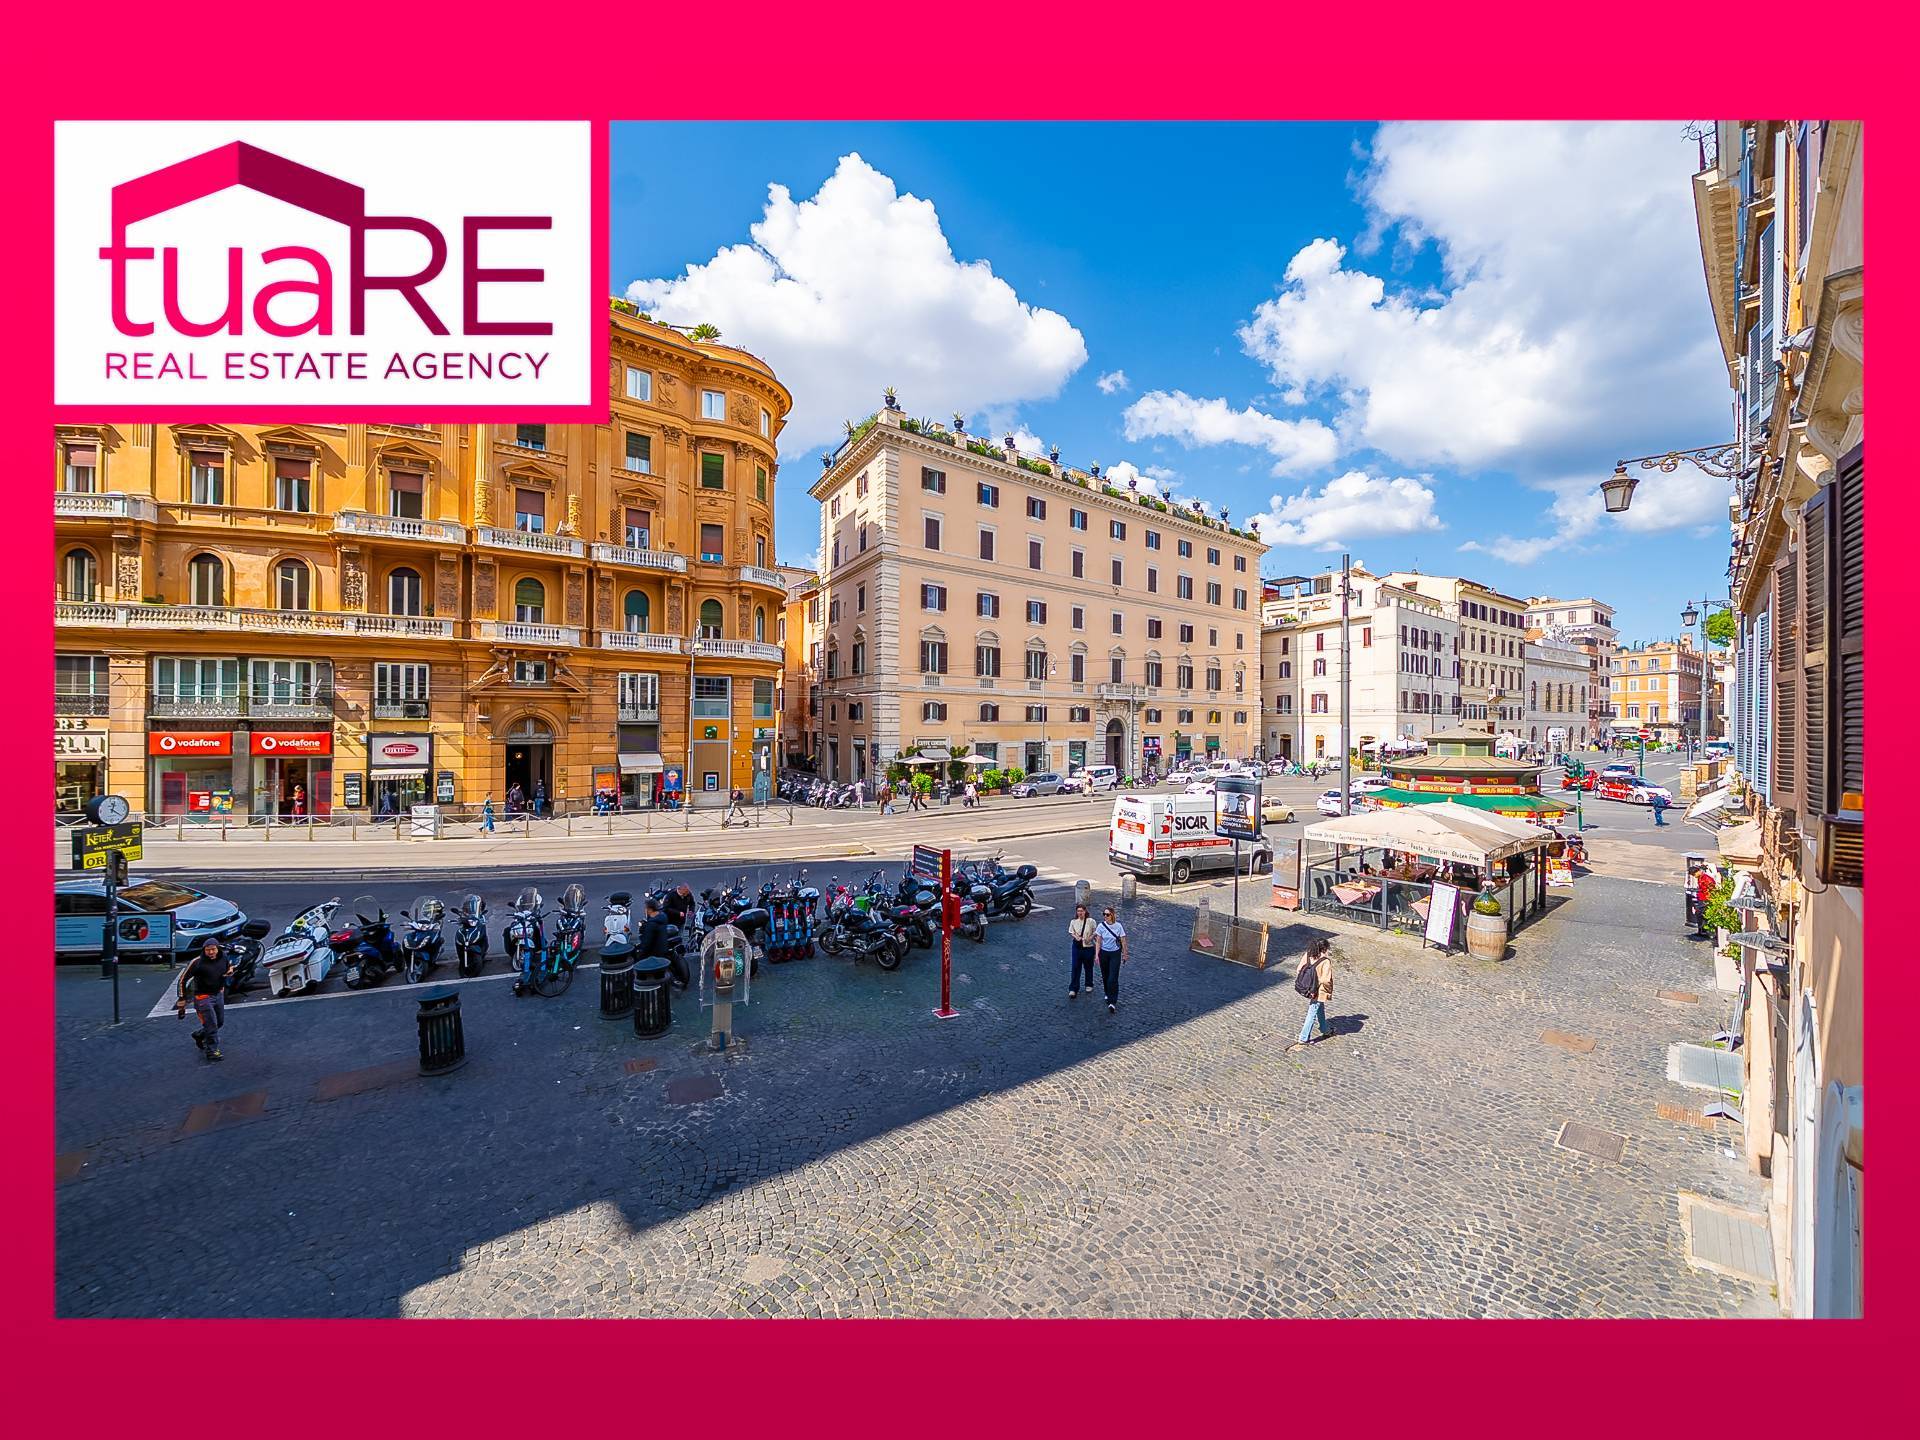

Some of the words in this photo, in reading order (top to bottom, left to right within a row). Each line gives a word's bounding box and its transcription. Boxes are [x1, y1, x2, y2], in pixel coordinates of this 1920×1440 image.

[177, 739, 221, 747] vodafone
[278, 739, 321, 747] vodafone
[1174, 815, 1210, 831] SICAR
[85, 832, 113, 847] KETER
[1451, 850, 1468, 861] Gluten
[1468, 853, 1480, 862] Free
